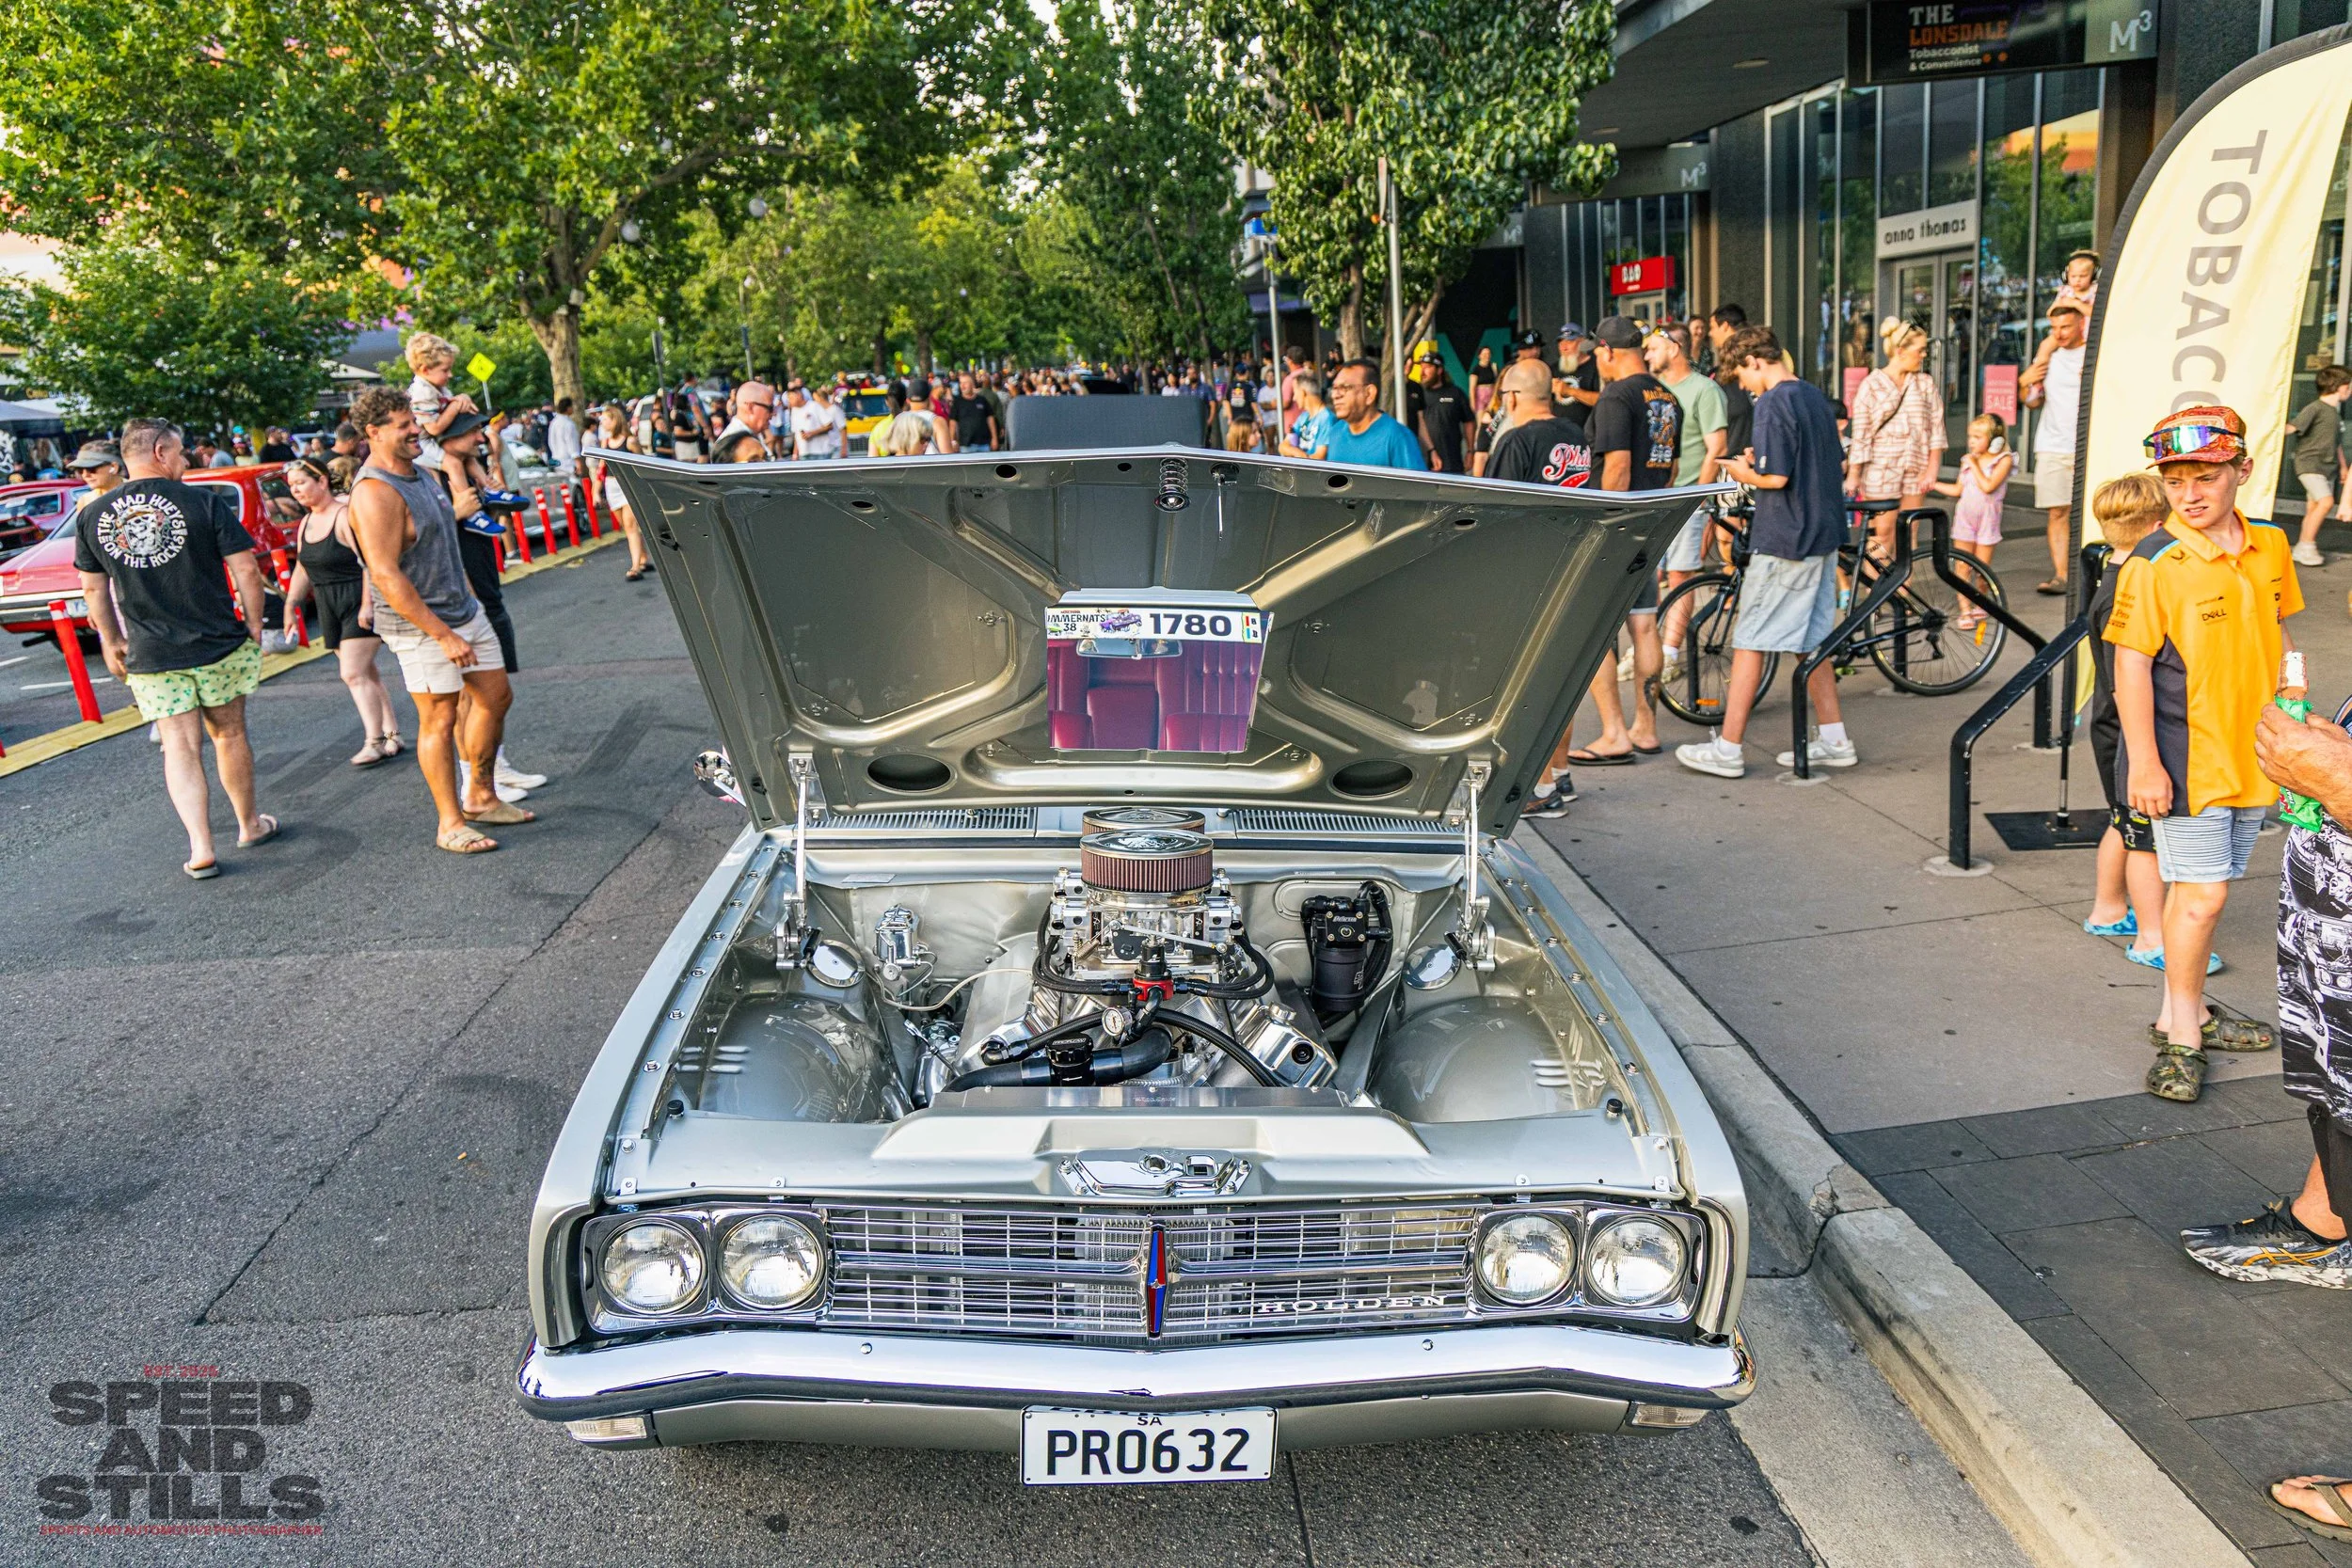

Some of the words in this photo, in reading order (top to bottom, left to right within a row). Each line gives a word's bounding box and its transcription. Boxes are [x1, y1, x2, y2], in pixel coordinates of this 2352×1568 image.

[1909, 4, 1954, 26] THE
[1909, 20, 2008, 46] LONSDALE
[1908, 42, 1979, 59] Tobacconist
[1909, 61, 1917, 71] &
[1919, 57, 1982, 70] Convenience
[1920, 217, 1966, 238] thomas
[1986, 395, 2014, 411] SALE
[97, 511, 115, 535] THE
[111, 493, 146, 514] MAD
[149, 493, 187, 530] HUEYS
[105, 543, 123, 560] ON
[123, 553, 149, 569] THE
[150, 536, 185, 568] ROCKS
[1063, 623, 1077, 632] 38
[1150, 613, 1232, 637] 1780
[1257, 1295, 1448, 1313] HOLDEN
[1136, 1417, 1163, 1426] SA
